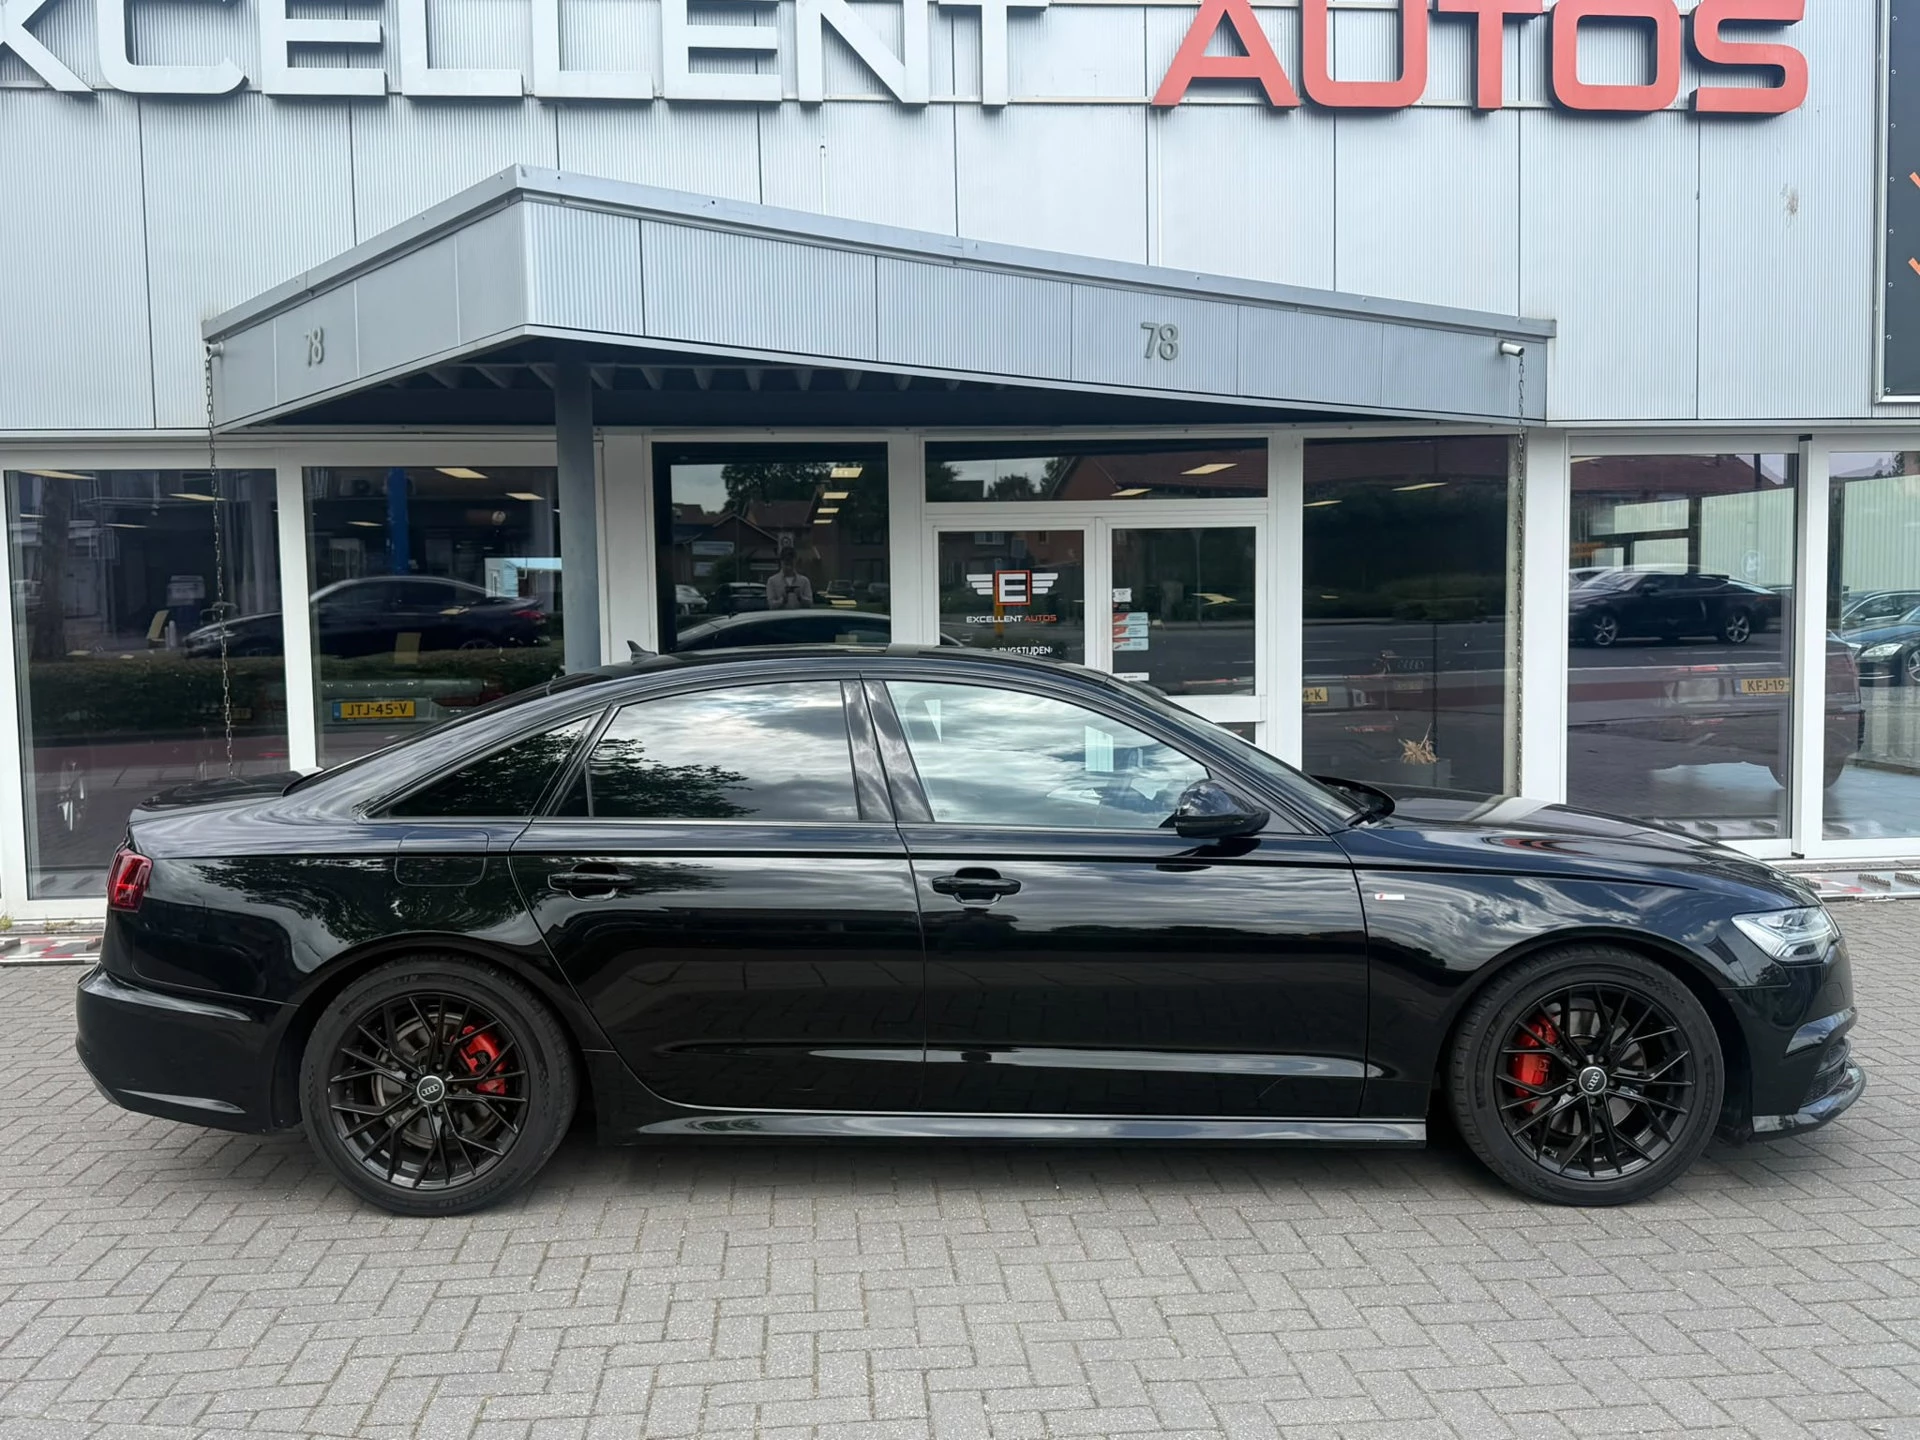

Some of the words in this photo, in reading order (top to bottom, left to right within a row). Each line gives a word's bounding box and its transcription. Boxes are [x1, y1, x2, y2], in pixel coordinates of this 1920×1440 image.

[1150, 0, 1809, 115] AUTOS
[304, 326, 325, 368] 78
[1140, 321, 1179, 361] 78
[998, 573, 1027, 602] E
[966, 615, 1023, 624] EXCELLENT
[1024, 614, 1057, 623] AUTOS
[347, 702, 407, 717] JTJ-45-V
